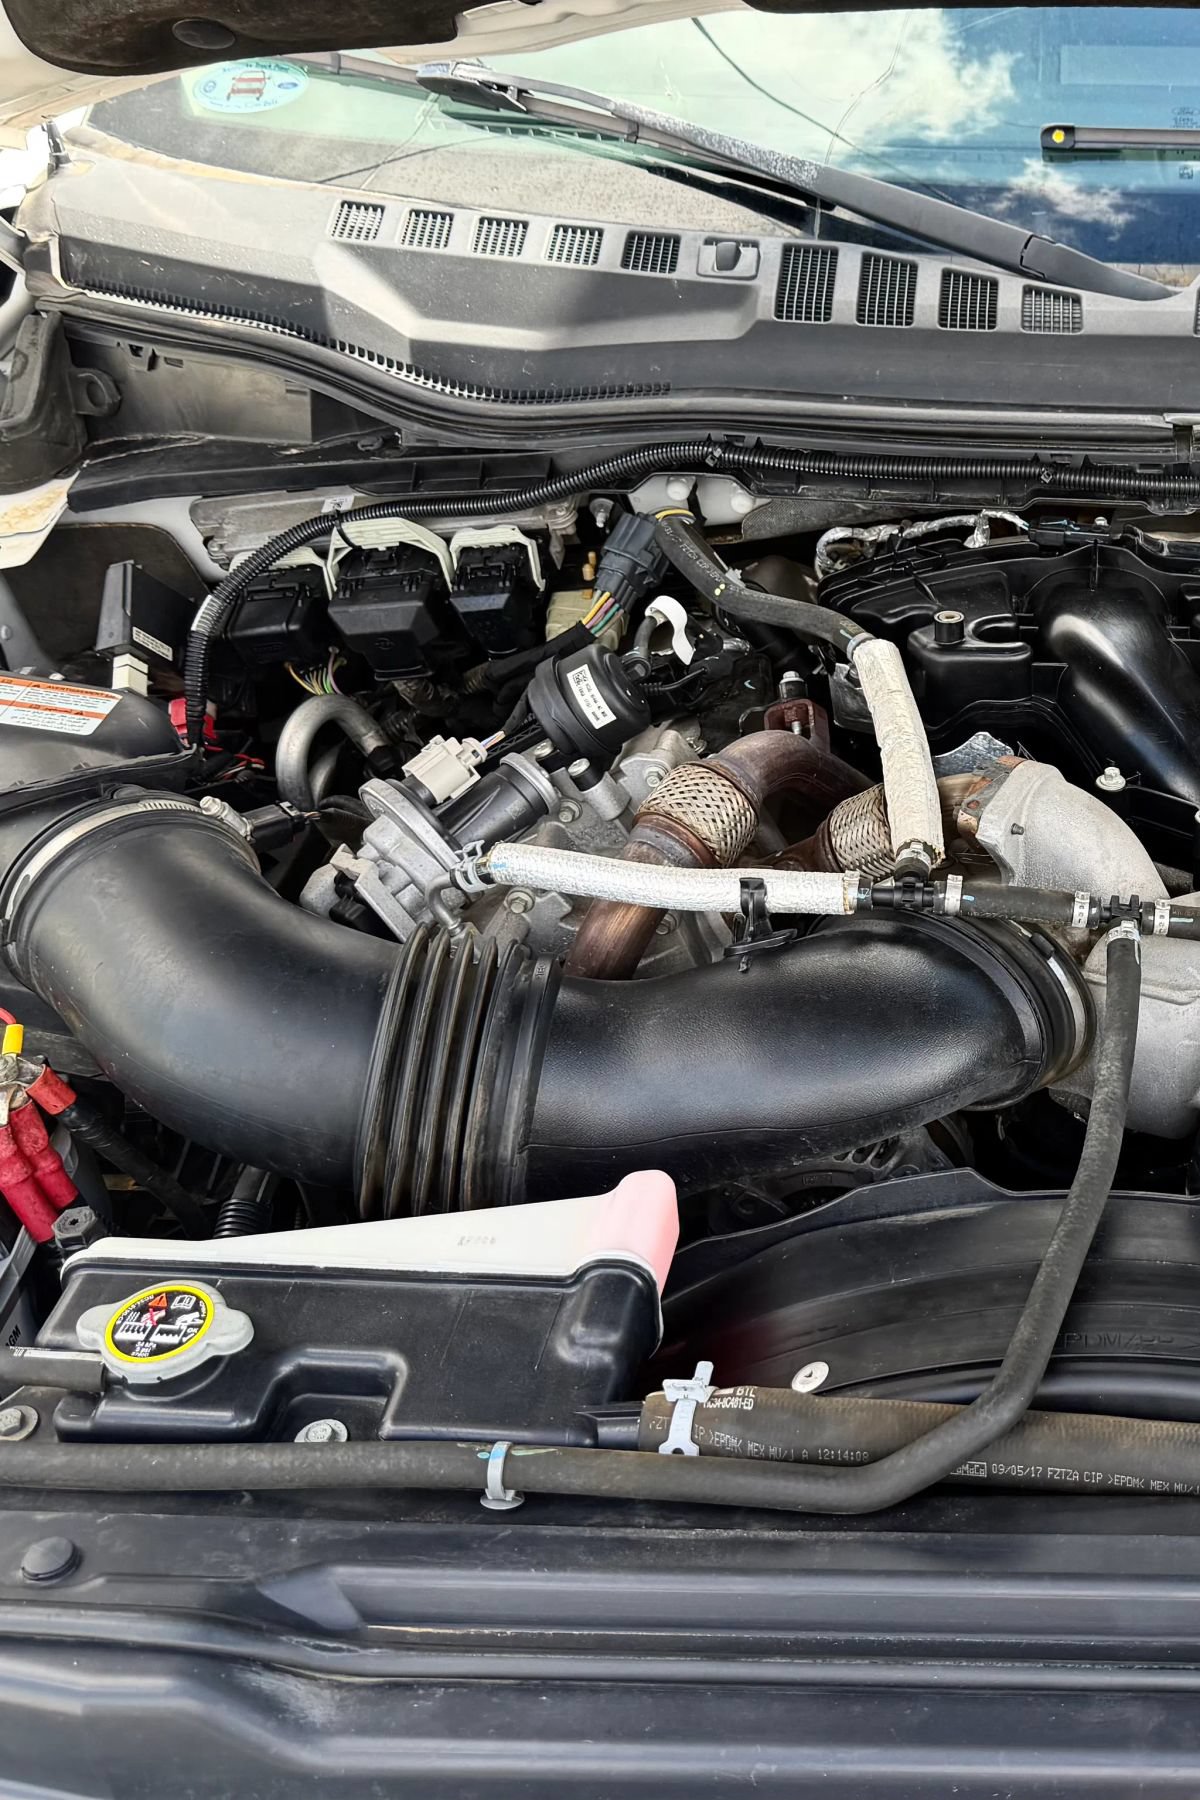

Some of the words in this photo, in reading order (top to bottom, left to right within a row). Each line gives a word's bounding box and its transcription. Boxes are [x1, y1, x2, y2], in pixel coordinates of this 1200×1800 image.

[991, 1463, 1043, 1478] 09/05/17
[1047, 1467, 1079, 1482] FZTZA
[1083, 1471, 1103, 1484] CIP
[1150, 1479, 1170, 1492] MEX
